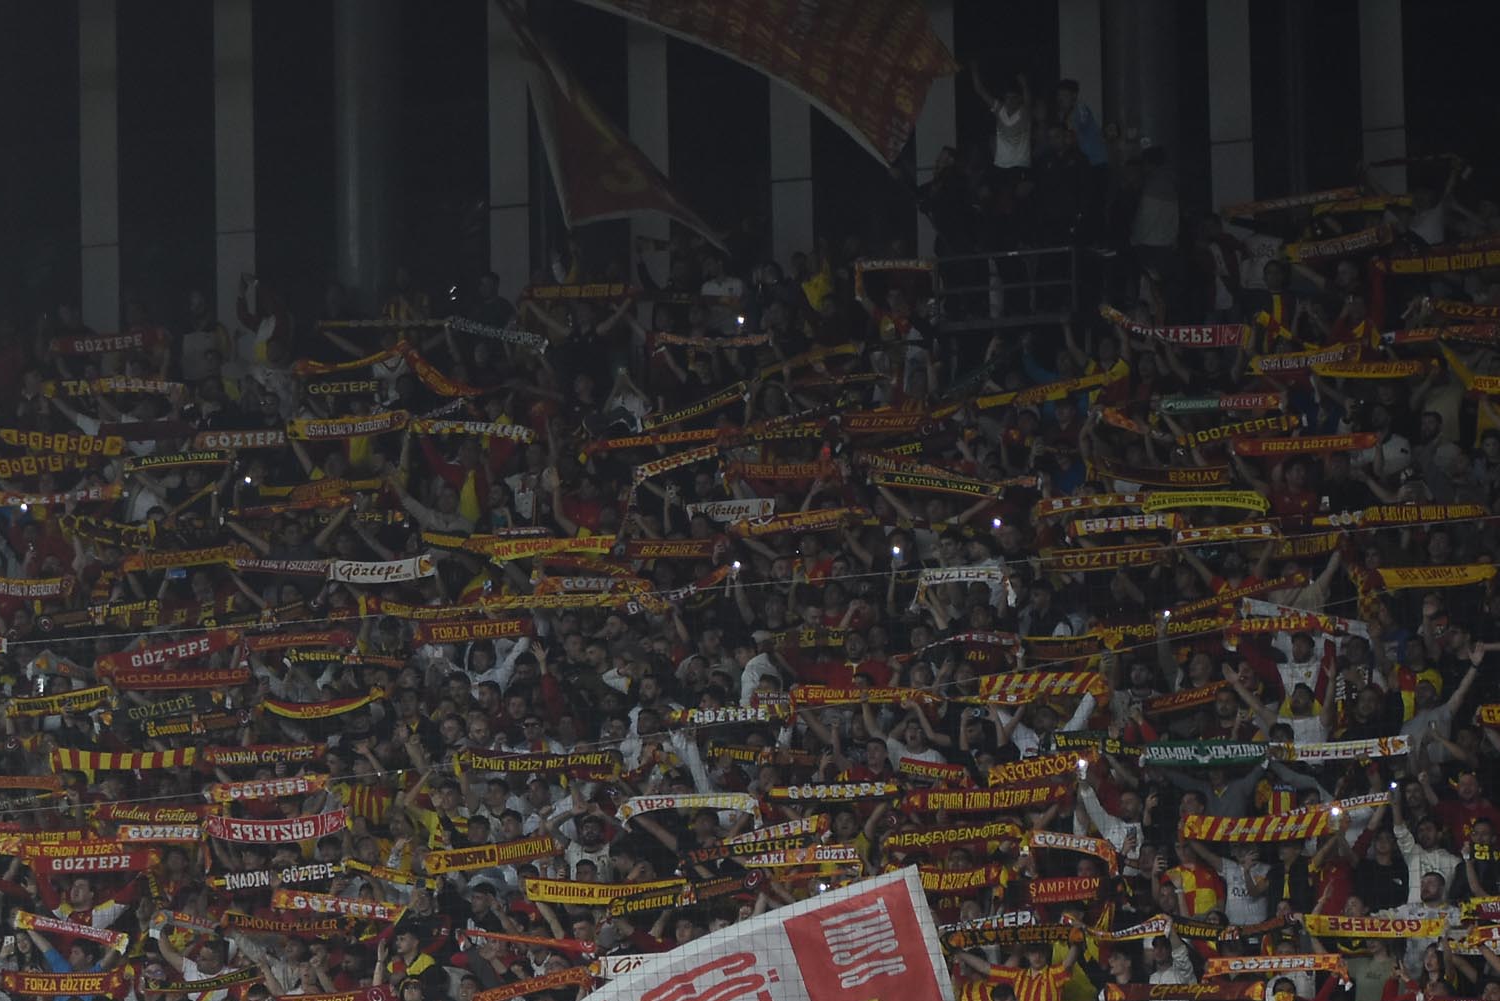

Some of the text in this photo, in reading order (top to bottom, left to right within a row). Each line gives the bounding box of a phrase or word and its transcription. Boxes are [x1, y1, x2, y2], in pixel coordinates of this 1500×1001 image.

[820, 897, 906, 988] THIS IS
[24, 976, 57, 991] FORZA
